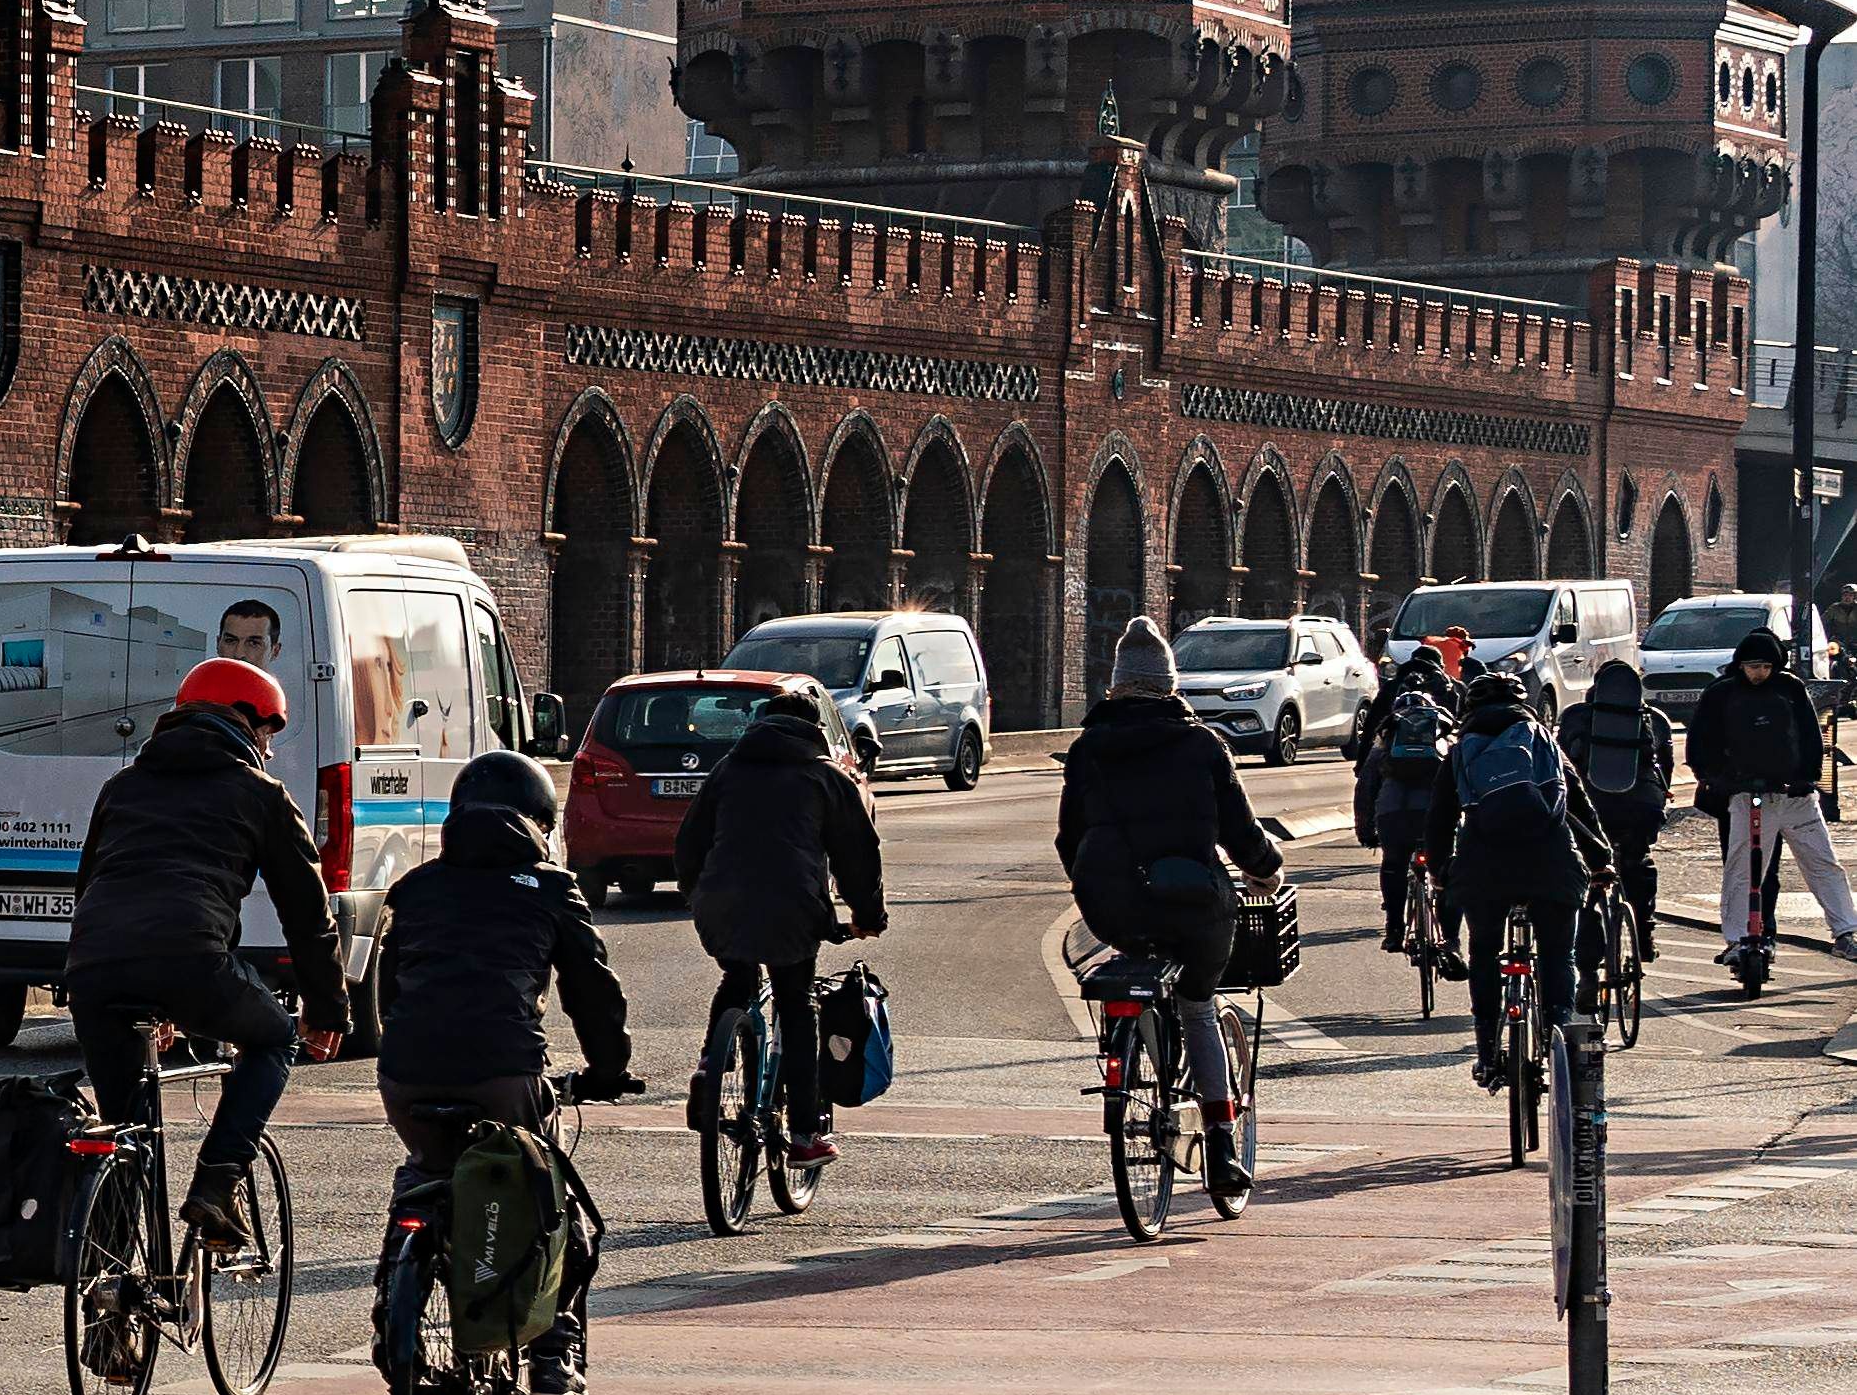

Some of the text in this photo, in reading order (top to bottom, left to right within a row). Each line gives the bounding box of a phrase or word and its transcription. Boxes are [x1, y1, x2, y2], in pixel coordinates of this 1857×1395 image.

[12, 821, 37, 833] 402
[41, 822, 72, 834] 1111
[23, 895, 47, 915] WH
